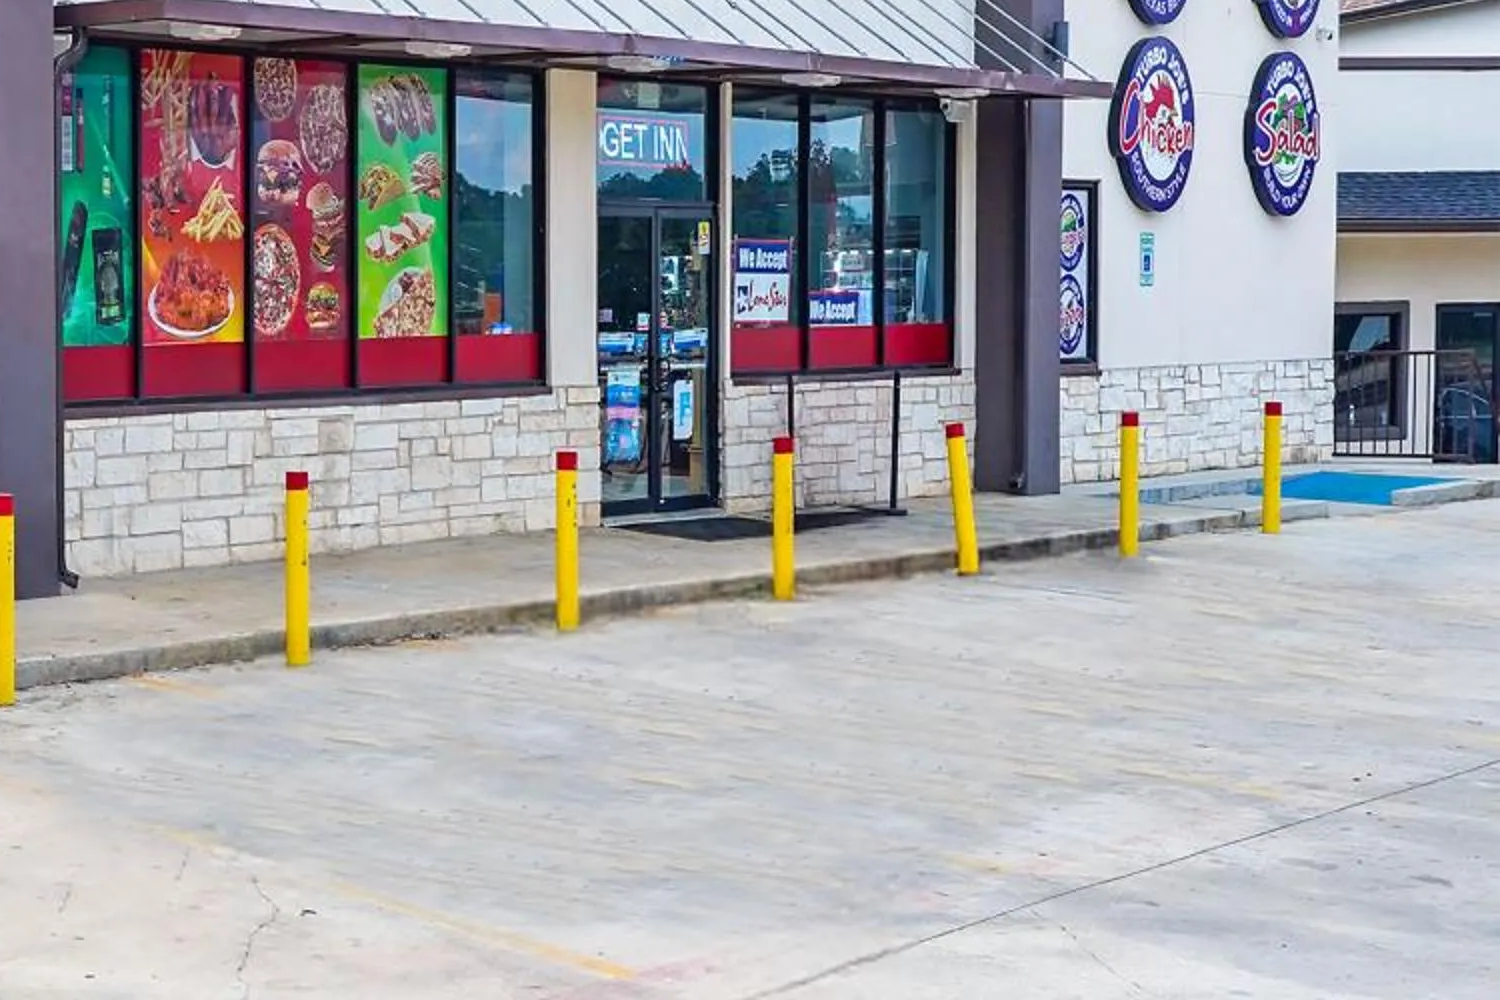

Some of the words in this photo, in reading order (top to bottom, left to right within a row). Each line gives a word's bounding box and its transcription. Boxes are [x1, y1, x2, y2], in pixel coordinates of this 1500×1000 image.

[1255, 97, 1321, 166] Salad
[738, 248, 755, 268] We
[756, 247, 787, 271] Accept
[809, 300, 825, 319] We
[825, 300, 856, 321] Accept
